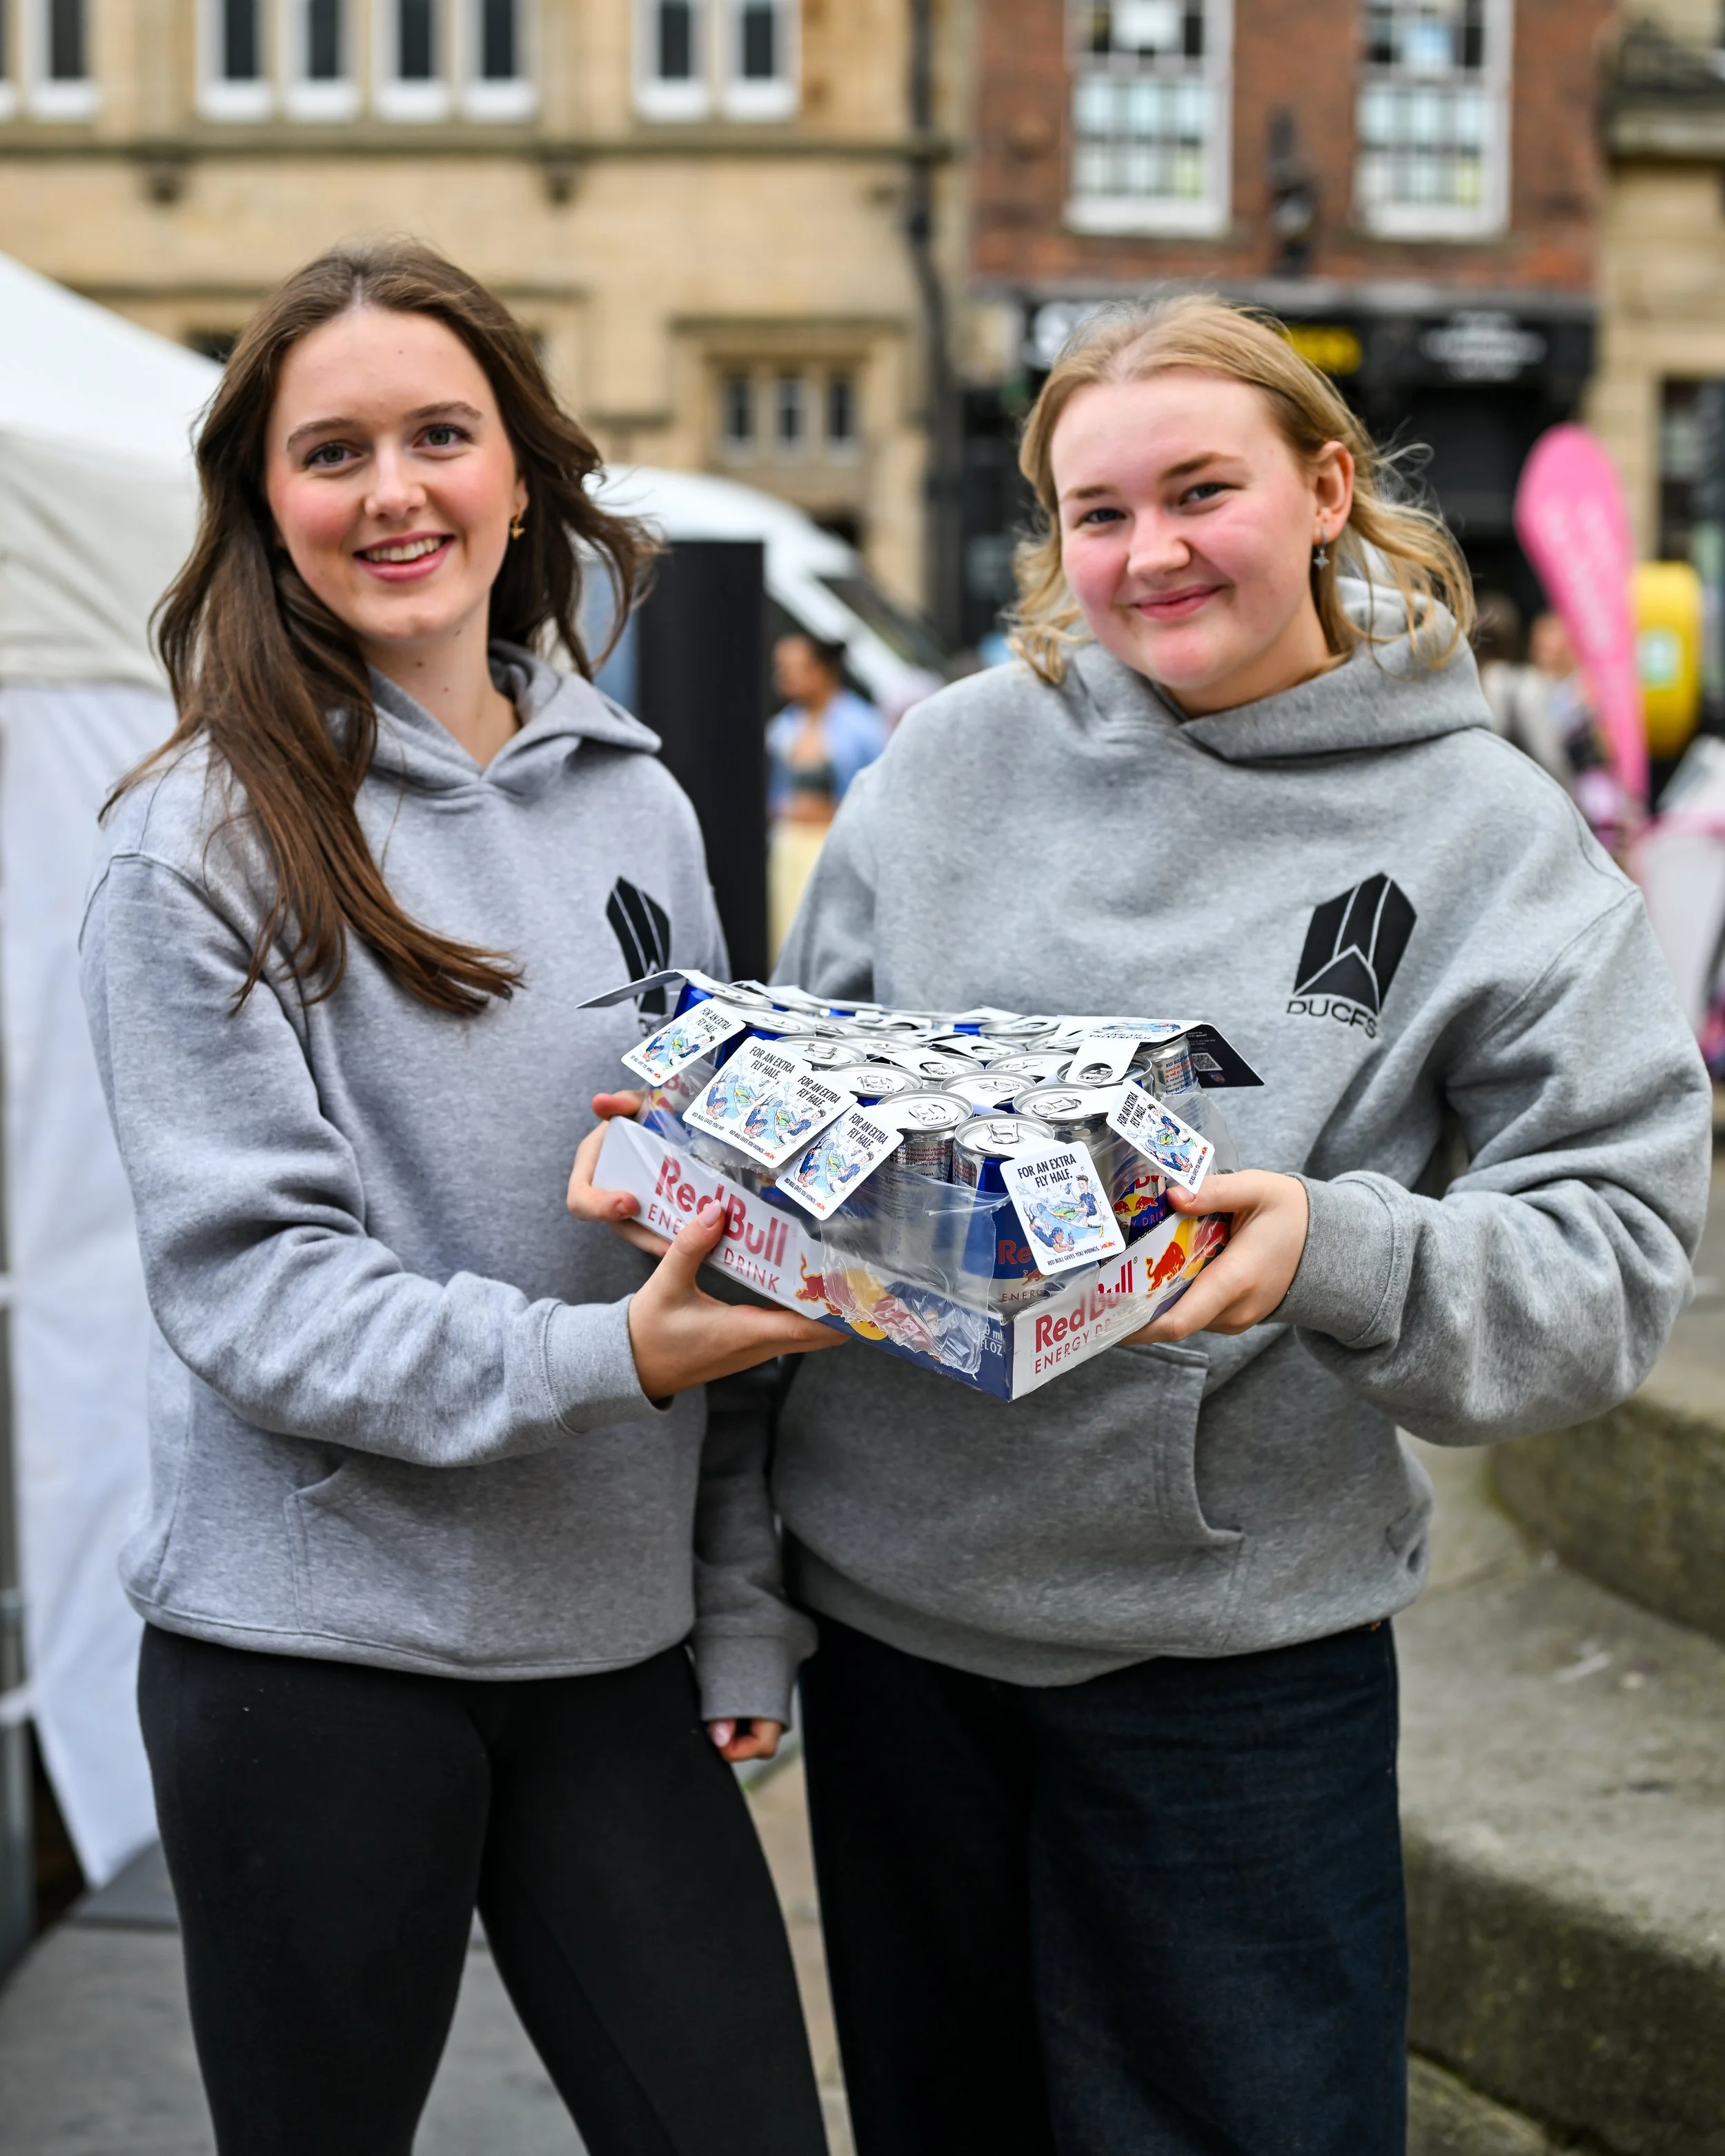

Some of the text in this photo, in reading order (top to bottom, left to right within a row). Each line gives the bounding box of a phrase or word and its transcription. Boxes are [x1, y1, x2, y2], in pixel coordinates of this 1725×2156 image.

[700, 1007, 713, 1017] FOR
[1286, 999, 1377, 1038] DUCFS
[749, 1046, 796, 1074] FOR AN EXTRA
[751, 1060, 780, 1080] FLY HALF.
[796, 1088, 825, 1108] FLY HALF.
[797, 1076, 841, 1104] FOR AN EXTRA
[1117, 1091, 1138, 1127] FOR AN EXTRA
[849, 1113, 889, 1145] FOR AN EXTRA
[1130, 1116, 1141, 1128] FLY
[847, 1127, 874, 1150] FLY HALF.
[1017, 1154, 1076, 1179] FOR AN EXTRA
[1035, 1169, 1073, 1188] FLY HALF.
[1142, 1207, 1166, 1226] DRIN
[998, 1240, 1033, 1265] Re
[724, 1247, 780, 1294] DRINK
[989, 1341, 1003, 1356] OZ
[1035, 1329, 1090, 1374] ENERGY
